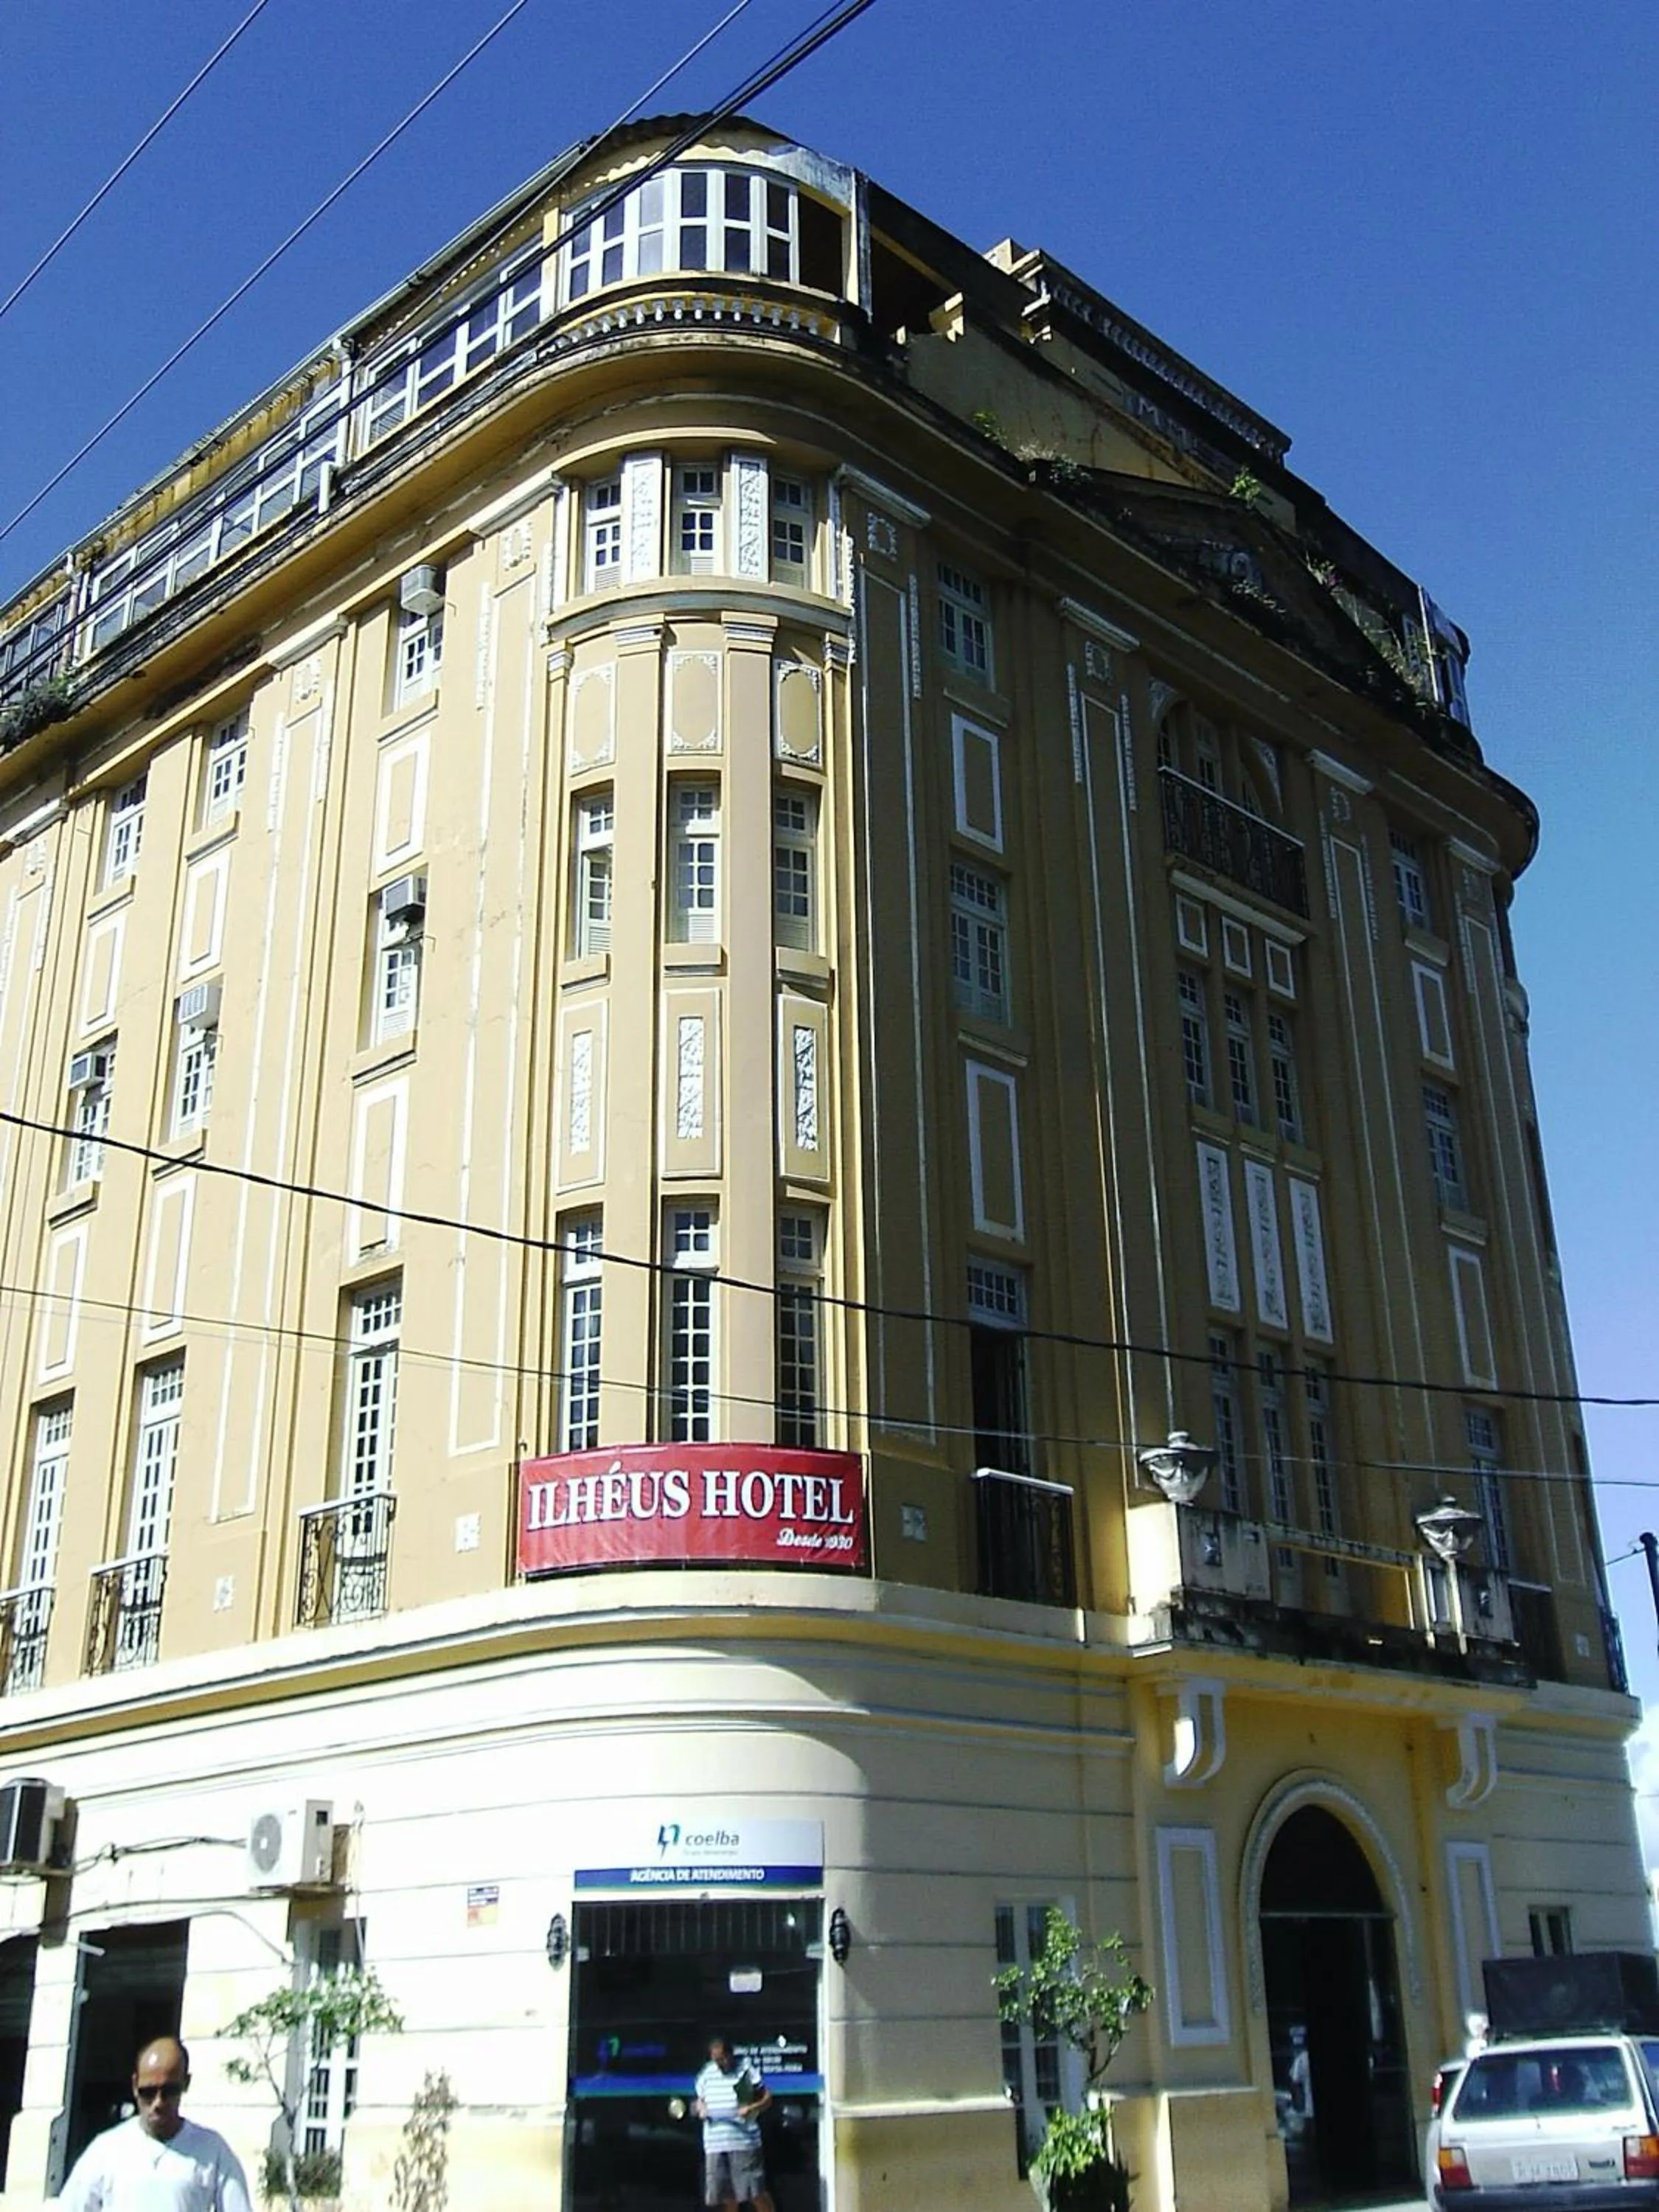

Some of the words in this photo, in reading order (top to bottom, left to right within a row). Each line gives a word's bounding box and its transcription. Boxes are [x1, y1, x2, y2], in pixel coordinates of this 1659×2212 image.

[527, 1462, 690, 1531] ILHÉUS
[702, 1471, 853, 1523] HOTEL
[776, 1527, 823, 1548] Desde
[685, 1830, 740, 1846] coelba
[630, 1868, 675, 1882] AGÊNCIA
[676, 1868, 691, 1881] DE
[692, 1868, 765, 1881] ATENDIMENTO
